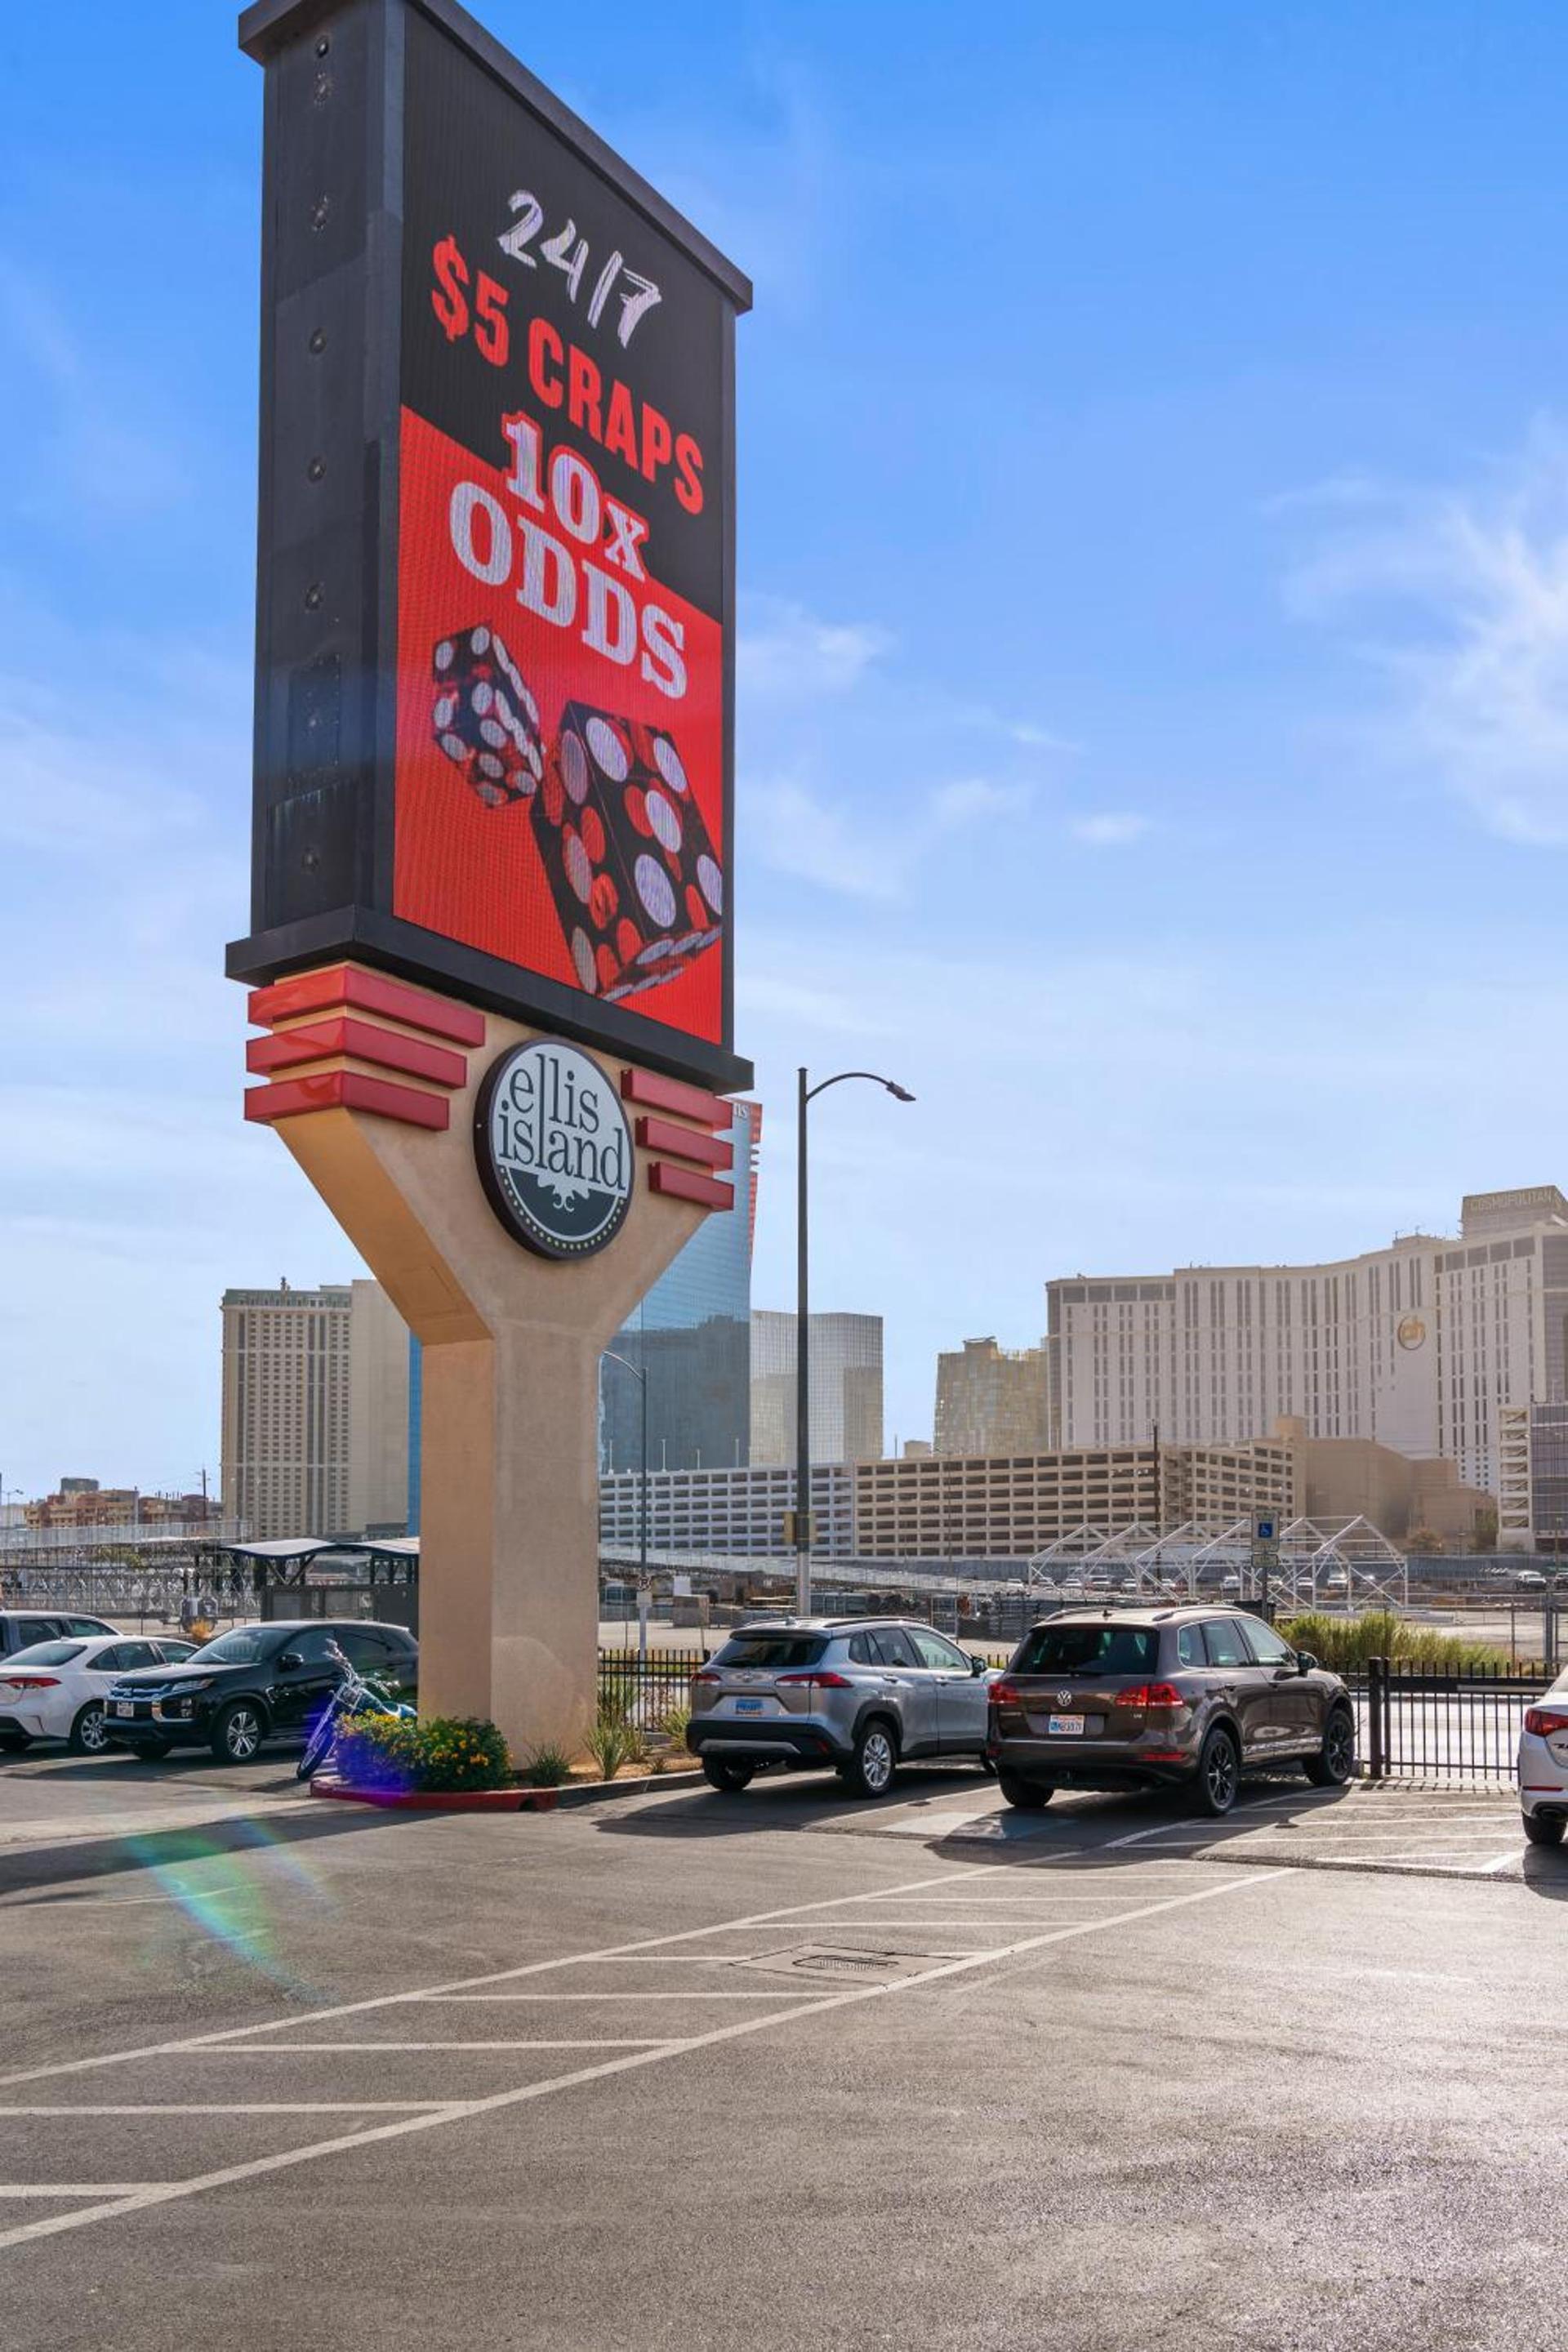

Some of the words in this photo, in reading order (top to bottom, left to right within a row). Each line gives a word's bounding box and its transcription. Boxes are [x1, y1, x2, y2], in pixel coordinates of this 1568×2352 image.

[497, 189, 662, 348] 24/7
[431, 233, 510, 366] $5
[528, 317, 703, 514] CRAPS
[449, 480, 688, 699] ODDS
[497, 1099, 626, 1192] island
[508, 1053, 599, 1135] ellis
